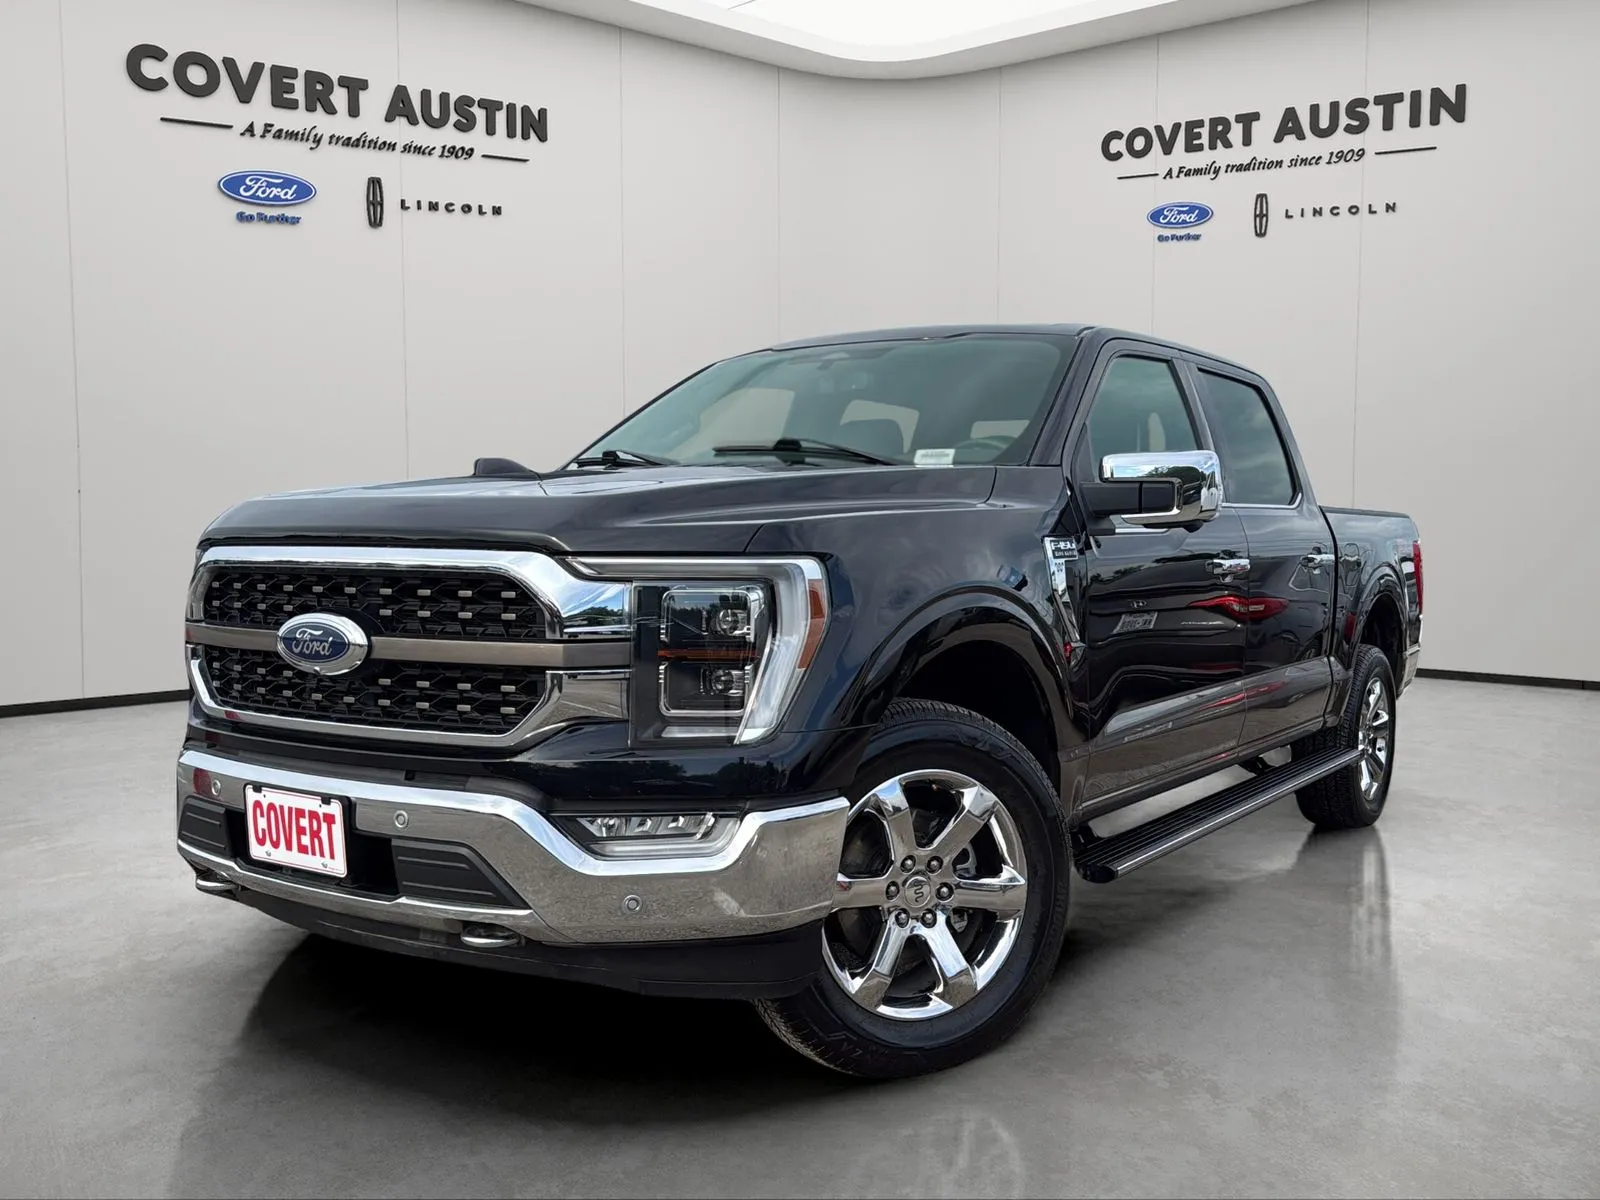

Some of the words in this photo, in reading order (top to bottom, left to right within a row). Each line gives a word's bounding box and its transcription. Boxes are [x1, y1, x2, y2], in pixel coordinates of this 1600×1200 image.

[126, 43, 369, 117] COVERT
[384, 84, 548, 143] AUSTIN
[1101, 111, 1260, 162] COVERT
[1273, 83, 1467, 144] AUSTIN
[240, 121, 256, 137] A
[260, 122, 324, 150] Family
[328, 131, 397, 152] tradition
[400, 140, 437, 157] since
[439, 144, 475, 160] 1909
[1163, 167, 1174, 179] A
[1176, 160, 1221, 180] Family
[1224, 156, 1283, 174] tradition
[1287, 153, 1322, 168] since
[1325, 147, 1366, 165] 1909
[239, 175, 298, 200] Ford
[236, 210, 255, 223] Go
[400, 198, 503, 216] LINCOLN
[1160, 206, 1199, 223] Ford
[1285, 201, 1397, 219] LINCOLN
[291, 628, 334, 657] Ford
[252, 799, 336, 860] COVERT
